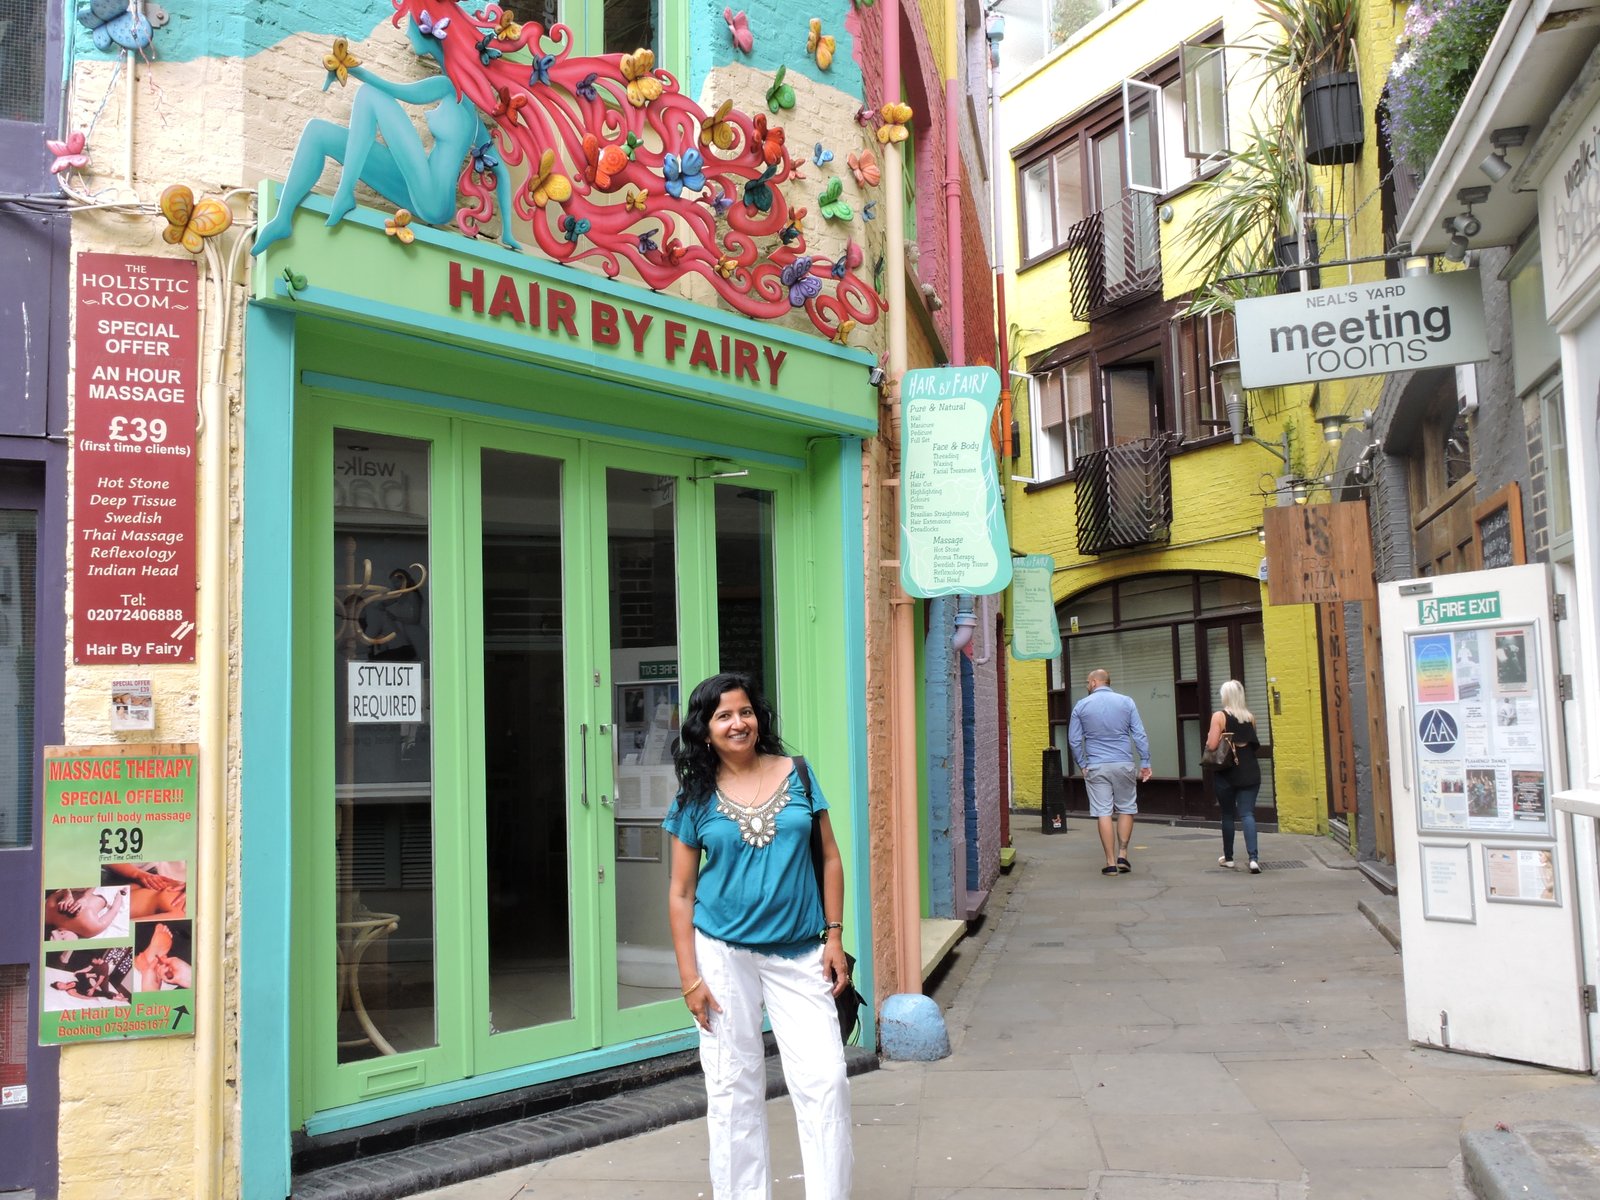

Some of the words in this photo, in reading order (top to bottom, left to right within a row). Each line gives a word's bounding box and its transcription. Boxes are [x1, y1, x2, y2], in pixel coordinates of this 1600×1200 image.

[125, 265, 147, 273] THE
[83, 274, 189, 293] HOLISTIC
[102, 292, 169, 309] ROOM
[1307, 291, 1357, 308] NEAL'S
[1366, 285, 1405, 300] YARD
[98, 320, 179, 338] SPECIAL
[449, 261, 579, 336] HAIR
[592, 300, 654, 352] BY
[665, 320, 787, 386] FAIRY
[1270, 305, 1451, 353] meeting
[106, 339, 169, 356] OFFER
[1307, 338, 1427, 374] rooms
[92, 366, 119, 380] AN
[126, 368, 181, 384] HOUR
[89, 385, 184, 403] MASSAGE
[909, 374, 935, 398] HAIR
[952, 373, 989, 396] FAIRY
[910, 405, 926, 413] Pure
[939, 403, 966, 411] Natural
[109, 417, 167, 442] £39
[80, 439, 110, 452] (first
[114, 442, 141, 453] time
[145, 443, 190, 457] clients)
[933, 443, 948, 451] Face
[961, 442, 979, 451] Body
[98, 478, 124, 488] Hot
[129, 478, 169, 489] Stone
[910, 471, 925, 479] Hair
[90, 495, 126, 509] Deep
[133, 496, 176, 506] Tissue
[105, 512, 162, 523] Swedish
[83, 529, 116, 541] Thai
[122, 530, 183, 545] Massage
[933, 537, 963, 546] Massage
[91, 547, 176, 562] Reflexology
[88, 565, 136, 575] Indian
[142, 565, 178, 576] Head
[121, 594, 145, 606] Tel:
[1440, 601, 1466, 617] FIRE
[1469, 598, 1497, 614] EXIT
[87, 610, 183, 621] 02072406888
[87, 644, 117, 655] Hair
[122, 644, 141, 657] By
[147, 643, 182, 656] Fairy
[358, 666, 413, 686] STYLIST
[354, 695, 416, 720] REQUIRED
[1429, 722, 1448, 742] AA
[49, 761, 120, 780] MASSAGE
[126, 759, 193, 779] THERAPY
[61, 791, 121, 806] SPECIAL
[126, 789, 184, 803] OFFER!!!
[52, 814, 66, 824] An
[70, 813, 93, 823] hour
[97, 813, 113, 822] full
[117, 812, 141, 823] body
[146, 812, 191, 822] massage
[100, 828, 143, 854] £39
[60, 1010, 76, 1022] At
[82, 1007, 108, 1021] Hair
[114, 1005, 131, 1020] by
[137, 1003, 170, 1018] Fairy
[58, 1025, 101, 1037] Booking
